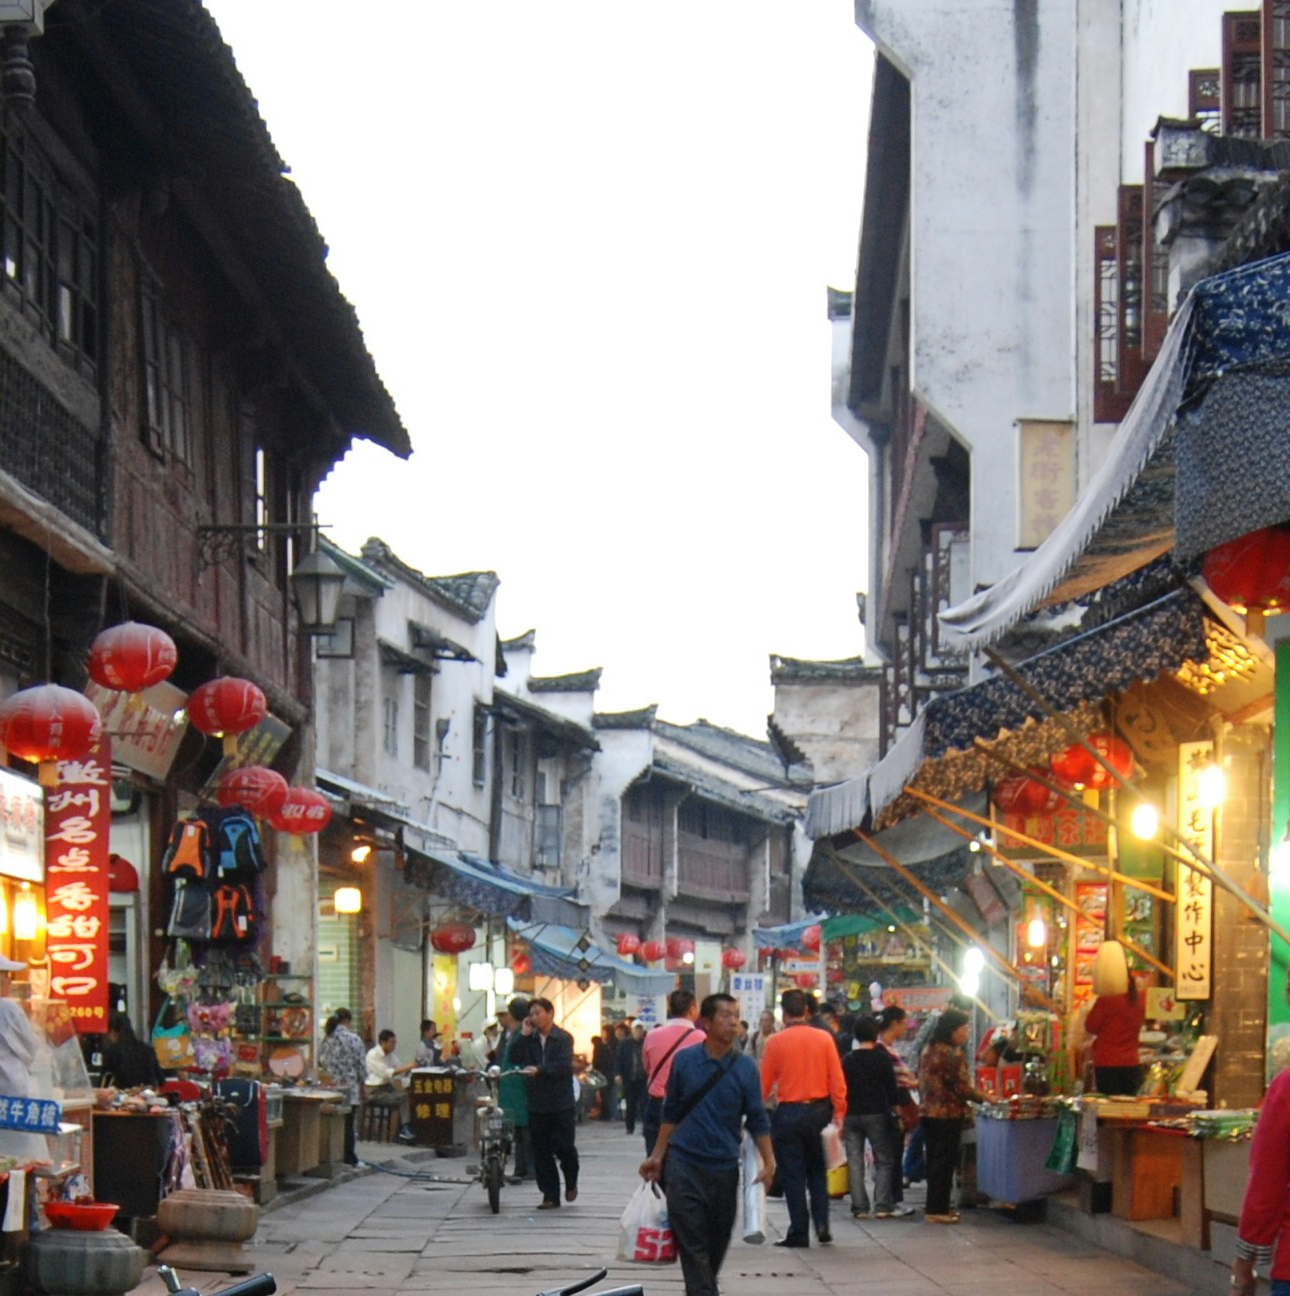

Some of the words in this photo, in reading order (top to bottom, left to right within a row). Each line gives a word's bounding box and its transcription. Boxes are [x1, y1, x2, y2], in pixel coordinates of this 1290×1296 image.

[46, 758, 108, 996] 徽州名点香甜可口
